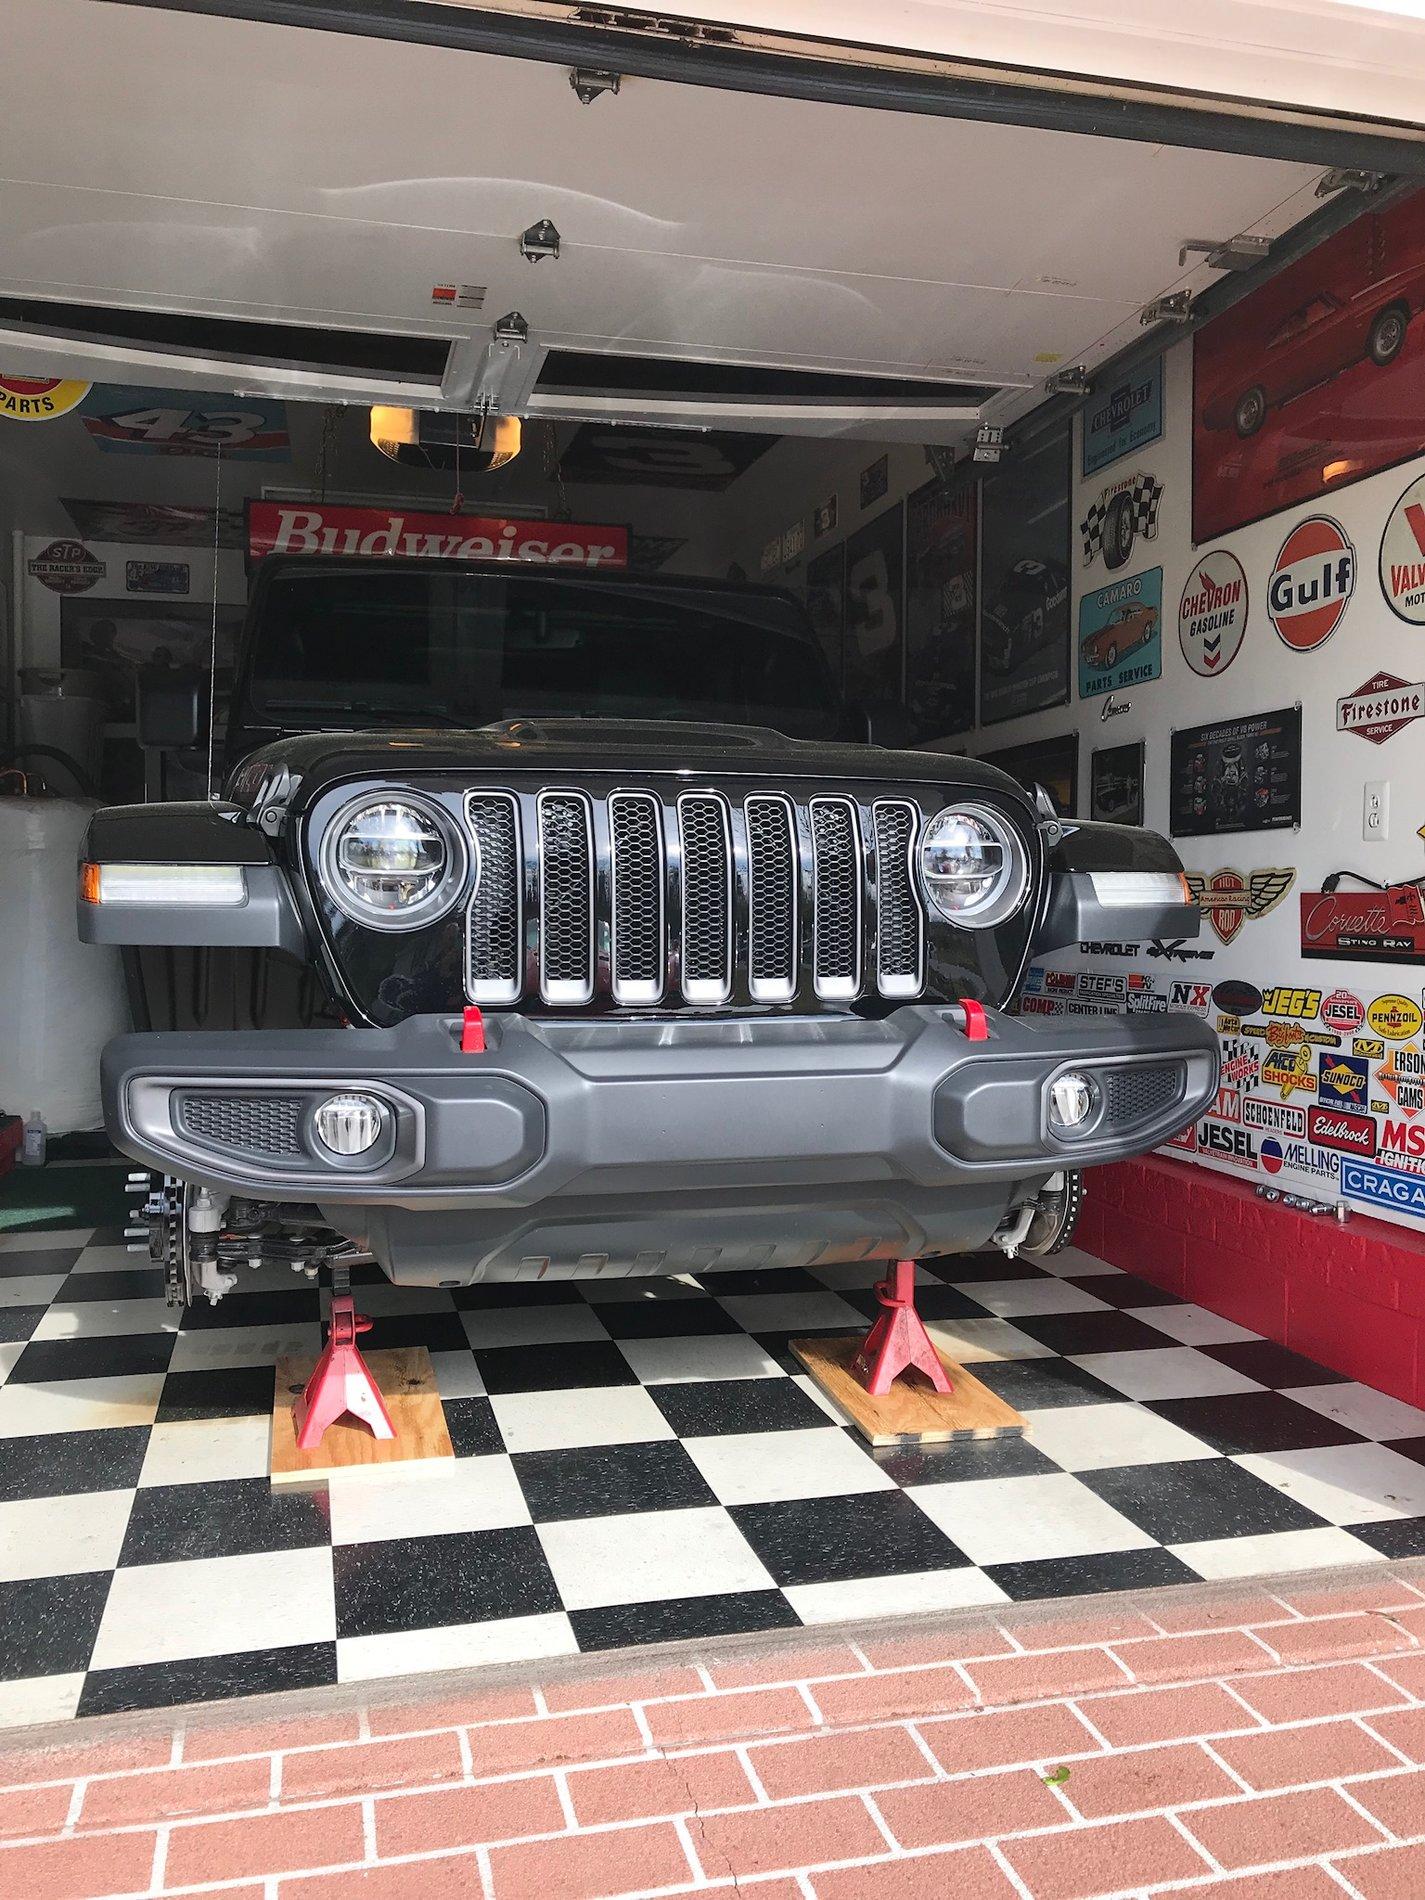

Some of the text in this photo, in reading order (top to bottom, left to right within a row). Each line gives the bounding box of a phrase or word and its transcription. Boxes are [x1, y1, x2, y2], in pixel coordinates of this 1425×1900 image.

[1094, 384, 1149, 430] CHEVROLET
[111, 408, 266, 444] 43
[267, 509, 616, 568] Budweiser
[52, 544, 82, 560] STP
[1096, 578, 1142, 609] CAMARO
[1271, 557, 1351, 612] Gulf
[1182, 579, 1242, 620] CHEVRON
[1189, 608, 1235, 638] GASOLINE
[1085, 664, 1153, 693] PARTS SERVICE
[1372, 680, 1389, 690] TIRE
[1341, 694, 1420, 726] Firestone
[1366, 724, 1393, 736] SERVICE
[1219, 876, 1235, 888] HOT
[1219, 909, 1236, 932] ROD
[1305, 895, 1391, 941] Corvette
[1080, 941, 1140, 957] CHEVROLET
[1079, 975, 1124, 993] STEF'S
[1171, 983, 1211, 1007] NX
[1335, 990, 1347, 999] 20
[1022, 996, 1055, 1014] COMP
[1068, 1002, 1097, 1014] CENTER
[1128, 993, 1167, 1013] SplitFire
[1262, 987, 1321, 1019] JEG'S
[1325, 1004, 1360, 1020] JESEL
[1372, 1012, 1418, 1023] PENNZOIL
[1221, 1054, 1249, 1075] ENGINE
[1231, 1061, 1259, 1082] WORKS
[1264, 1069, 1315, 1089] SHOCKS
[1323, 1071, 1364, 1088] SUNOCO
[1397, 1086, 1423, 1109] CAMS
[1245, 1102, 1303, 1132] SCHOENFELD
[1198, 1122, 1258, 1160] JESEL
[1313, 1116, 1369, 1145] Edelbrock
[1381, 1119, 1425, 1156] MS
[1284, 1143, 1340, 1173] MELLING
[1284, 1162, 1336, 1180] ENGINE PARTS
[1347, 1171, 1425, 1205] CRAGA
